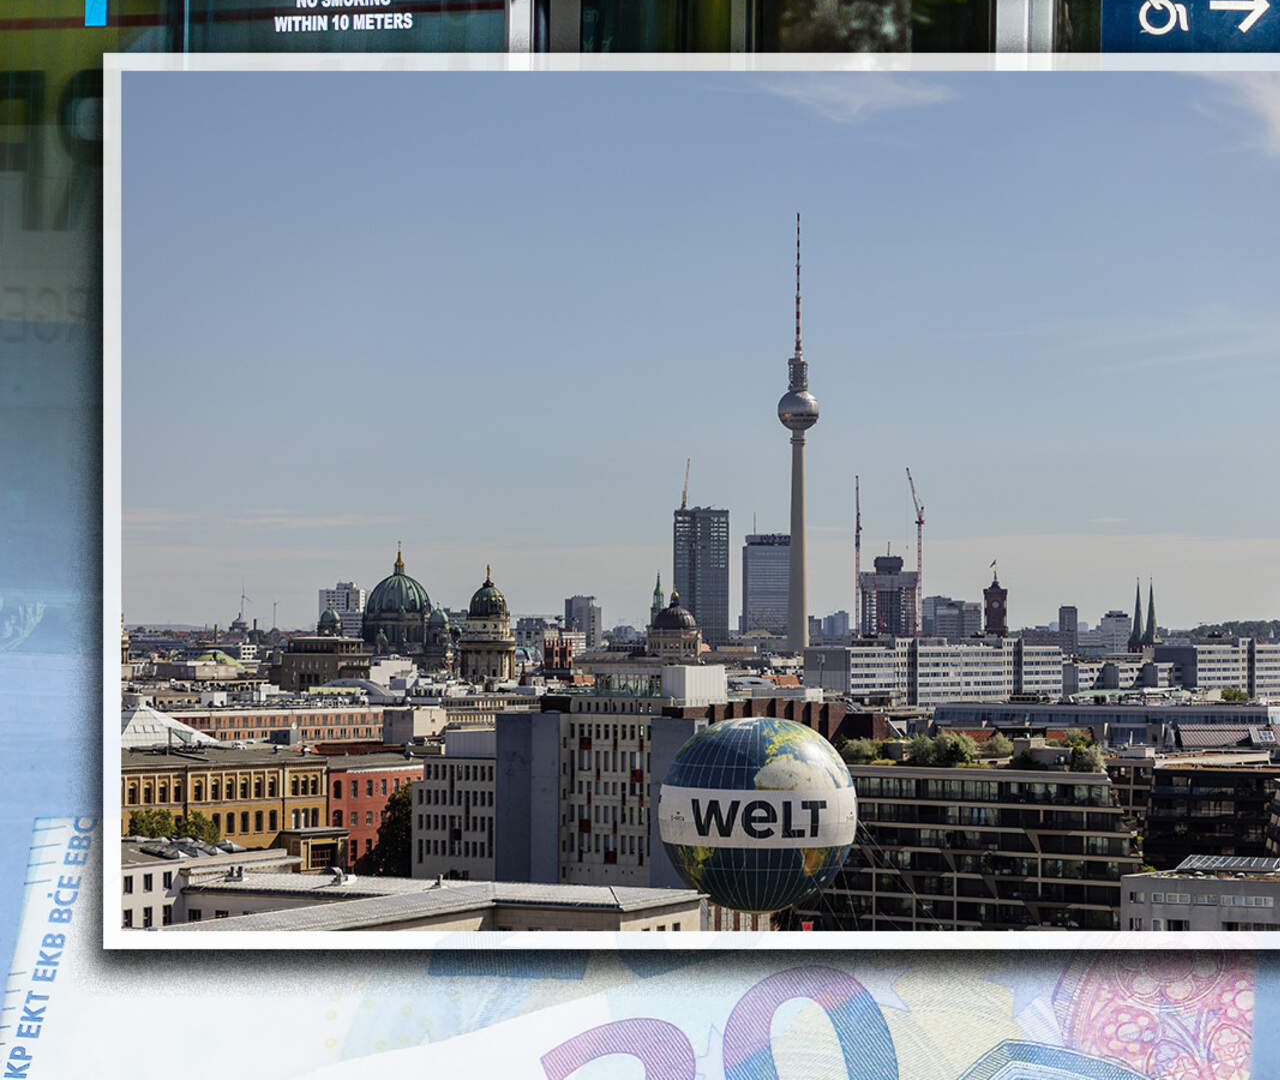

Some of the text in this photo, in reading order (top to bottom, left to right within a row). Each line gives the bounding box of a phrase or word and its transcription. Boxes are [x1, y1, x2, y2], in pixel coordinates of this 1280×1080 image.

[274, 12, 414, 32] WITHIN 10 METERS
[32, 932, 66, 983] EKB
[16, 989, 51, 1039] EKT
